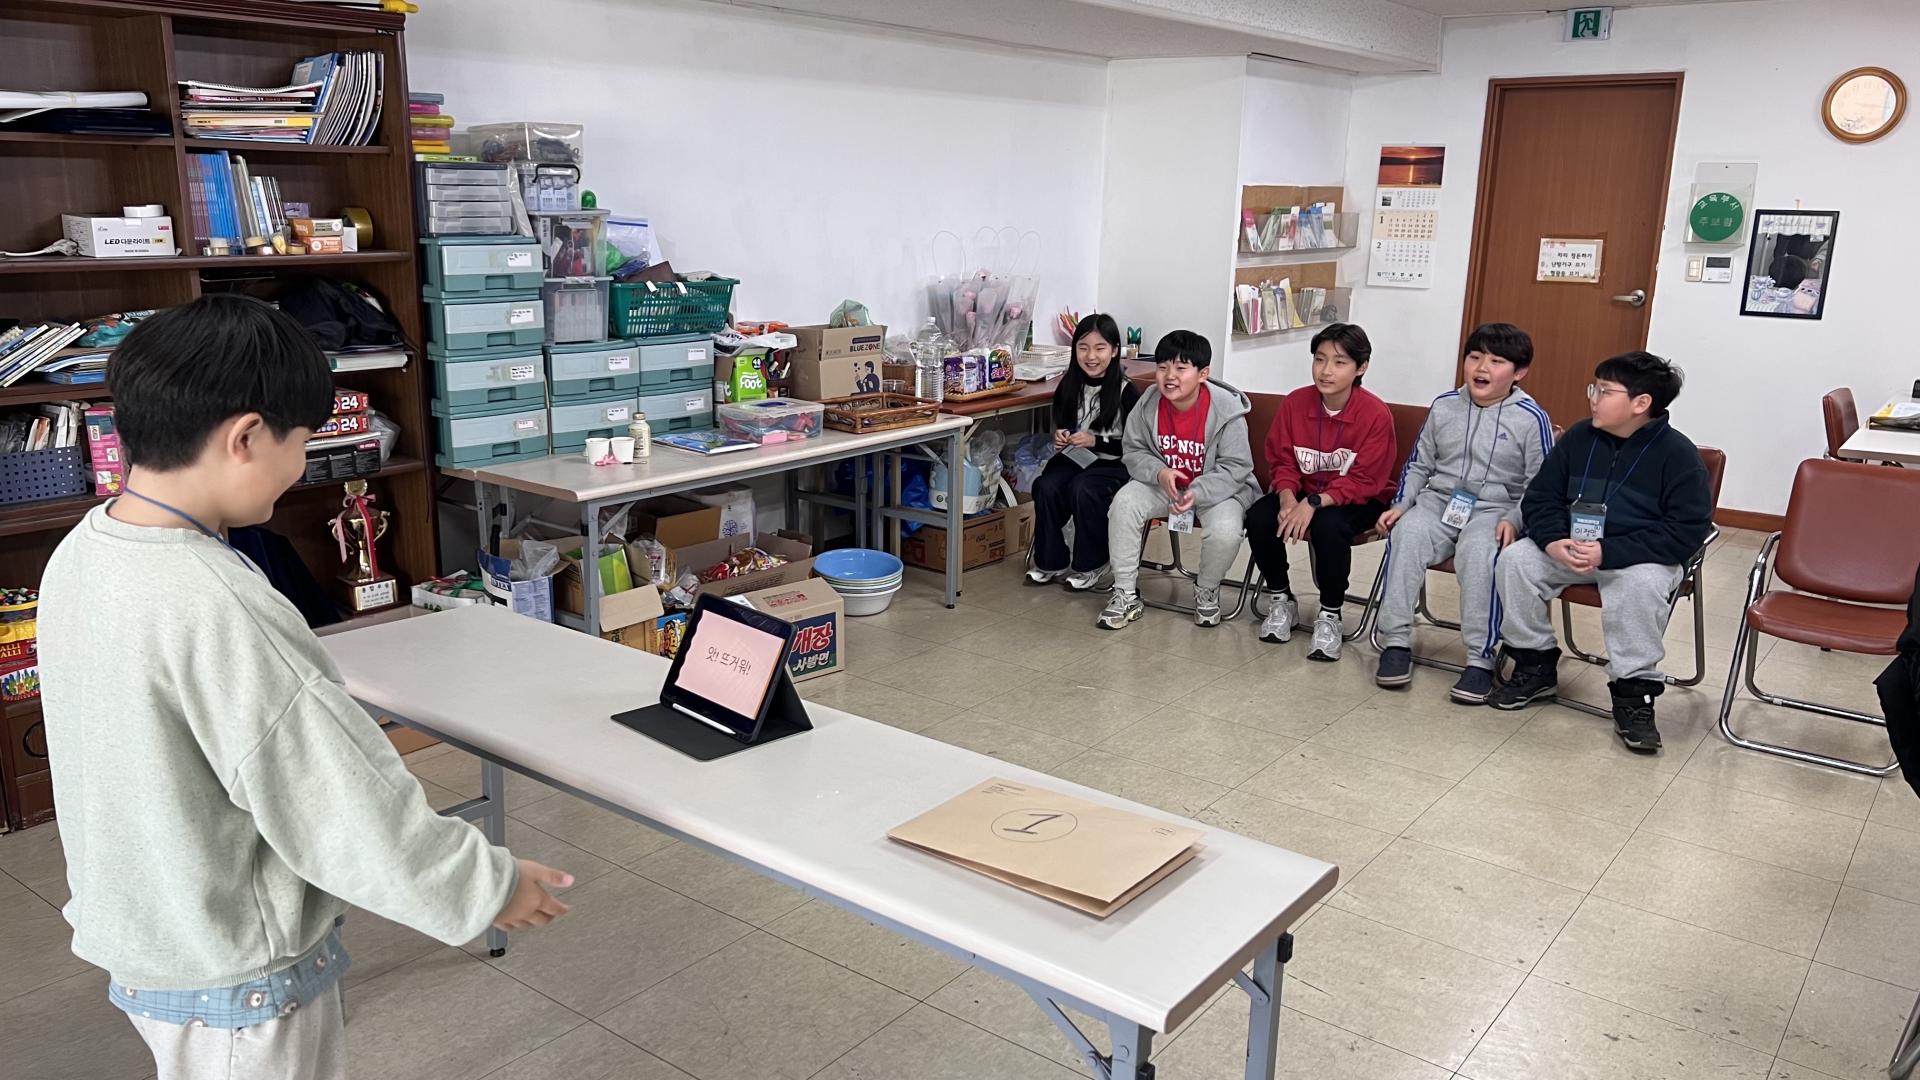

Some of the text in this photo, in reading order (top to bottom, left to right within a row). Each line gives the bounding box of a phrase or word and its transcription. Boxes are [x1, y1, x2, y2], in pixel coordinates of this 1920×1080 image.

[1698, 195, 1740, 211] 교육부서
[341, 395, 359, 410] 24
[341, 417, 359, 432] 24
[1322, 450, 1350, 472] YOR
[792, 621, 833, 655] 개장
[0, 643, 20, 652] ALLI
[0, 648, 21, 657] ALLI
[706, 646, 752, 675] 앗! 뜨거워!
[792, 651, 830, 672] 사발면
